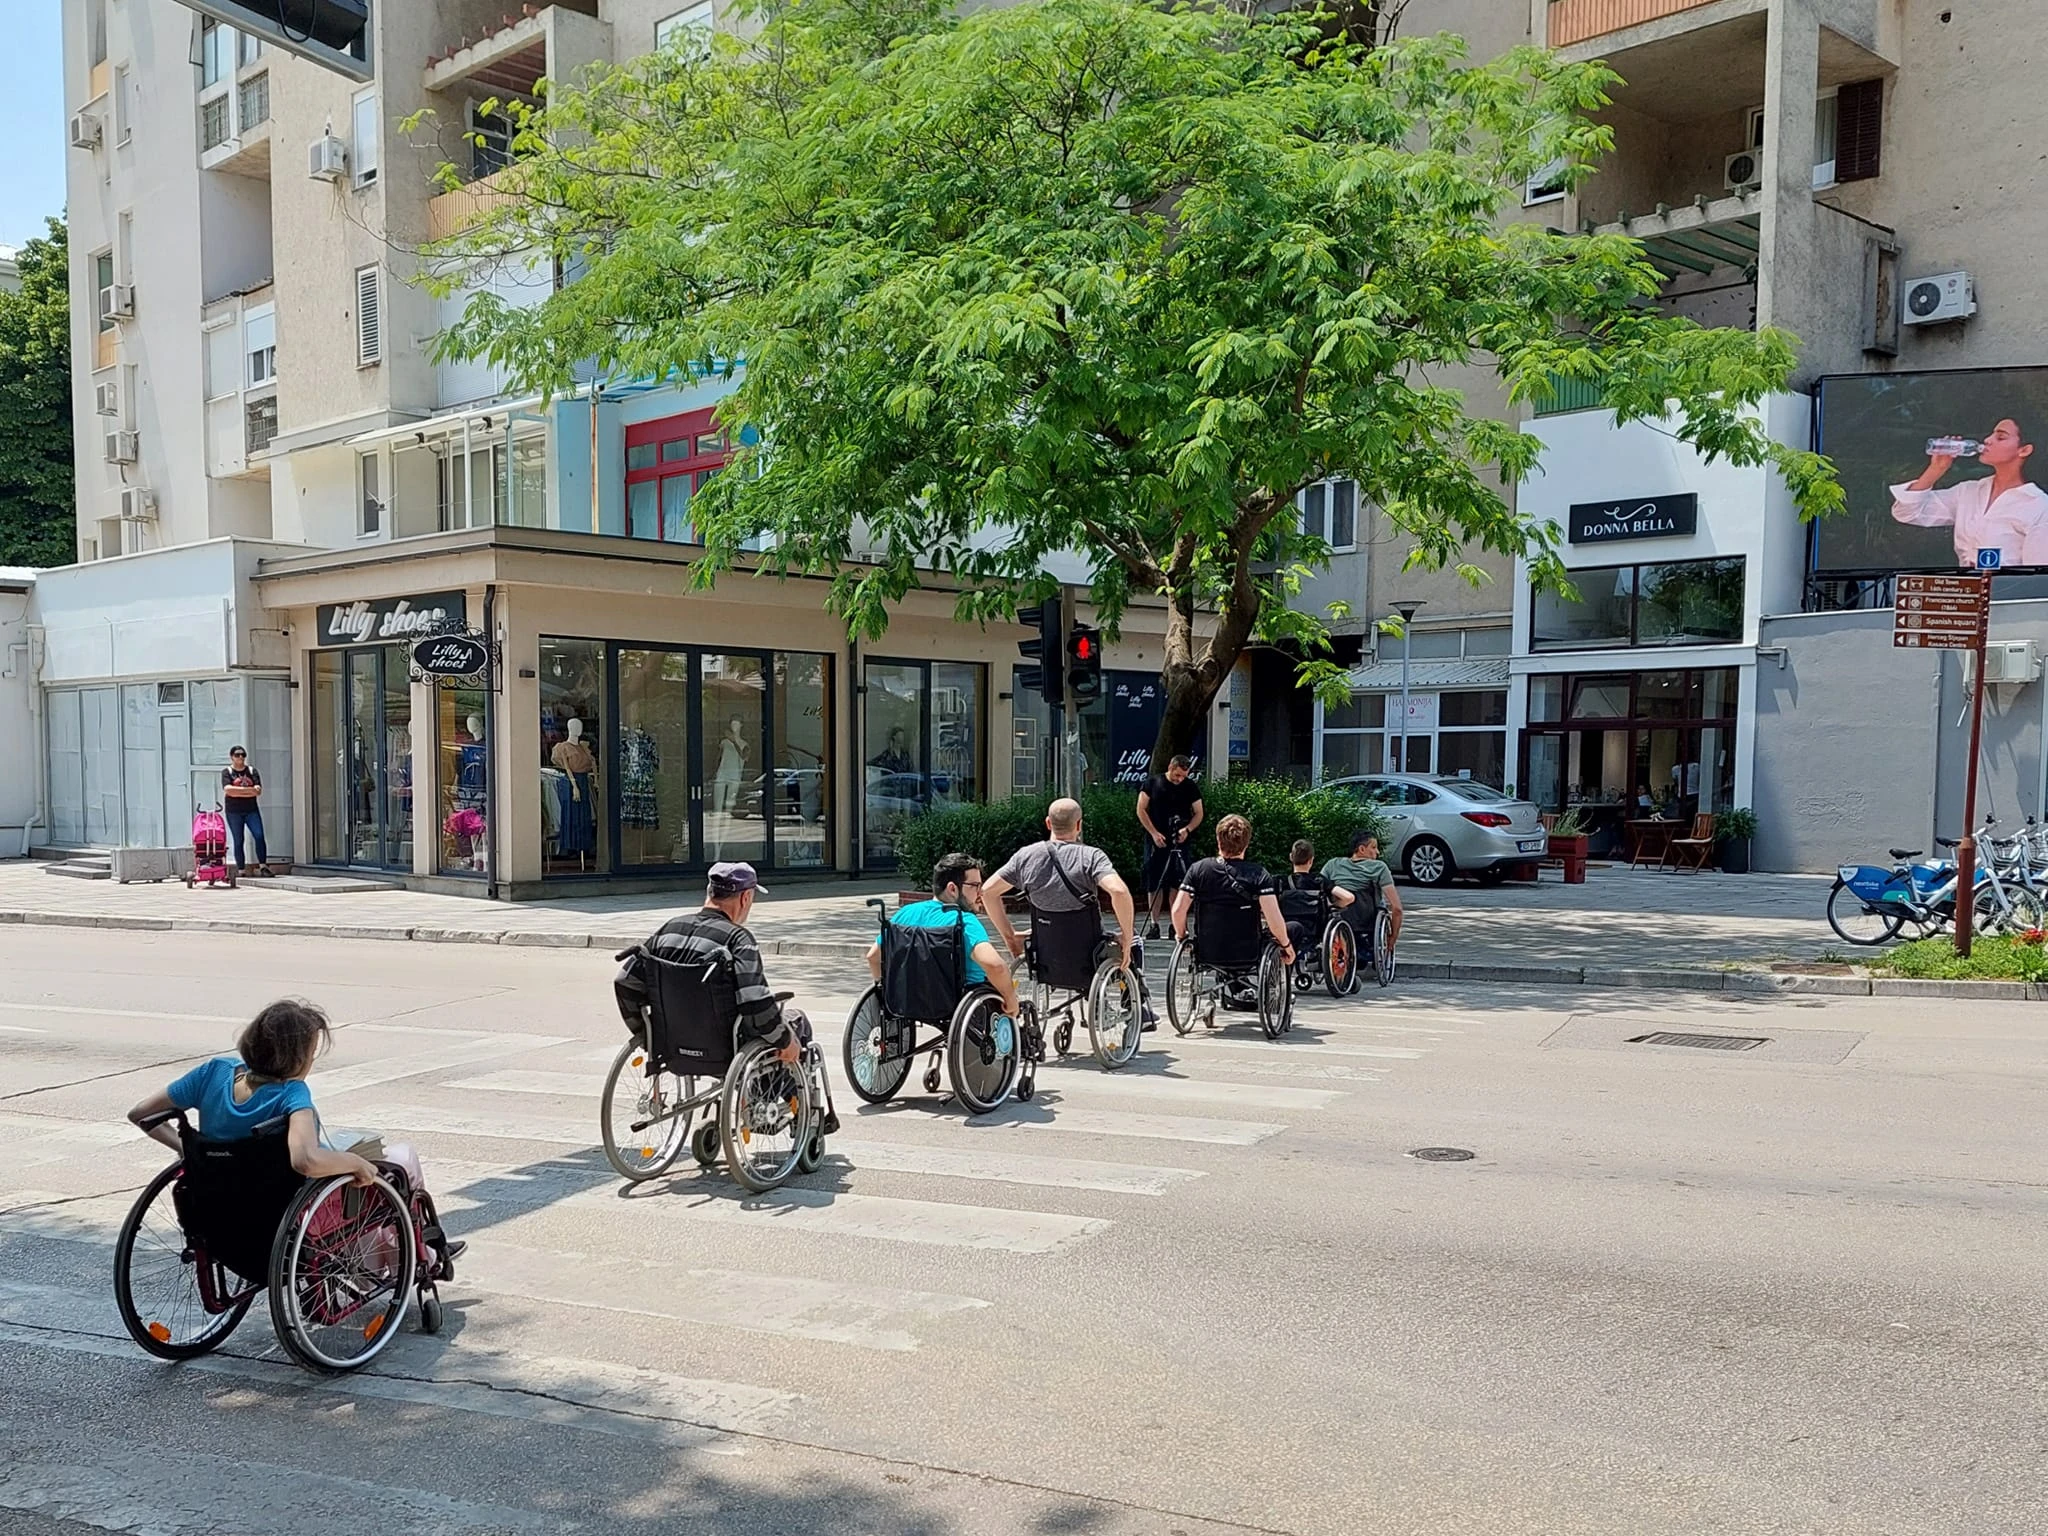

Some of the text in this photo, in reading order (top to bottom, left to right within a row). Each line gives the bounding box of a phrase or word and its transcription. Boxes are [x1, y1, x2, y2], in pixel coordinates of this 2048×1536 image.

[1583, 518, 1674, 536] DONNA BELLA
[329, 601, 377, 642] Lilly
[1926, 617, 1976, 627] Spanish square
[431, 644, 463, 660] Lilly
[428, 655, 467, 669] shoes
[1392, 697, 1432, 707] HAMONIJA
[1118, 749, 1151, 770] Lilly
[1113, 766, 1148, 783] shoe
